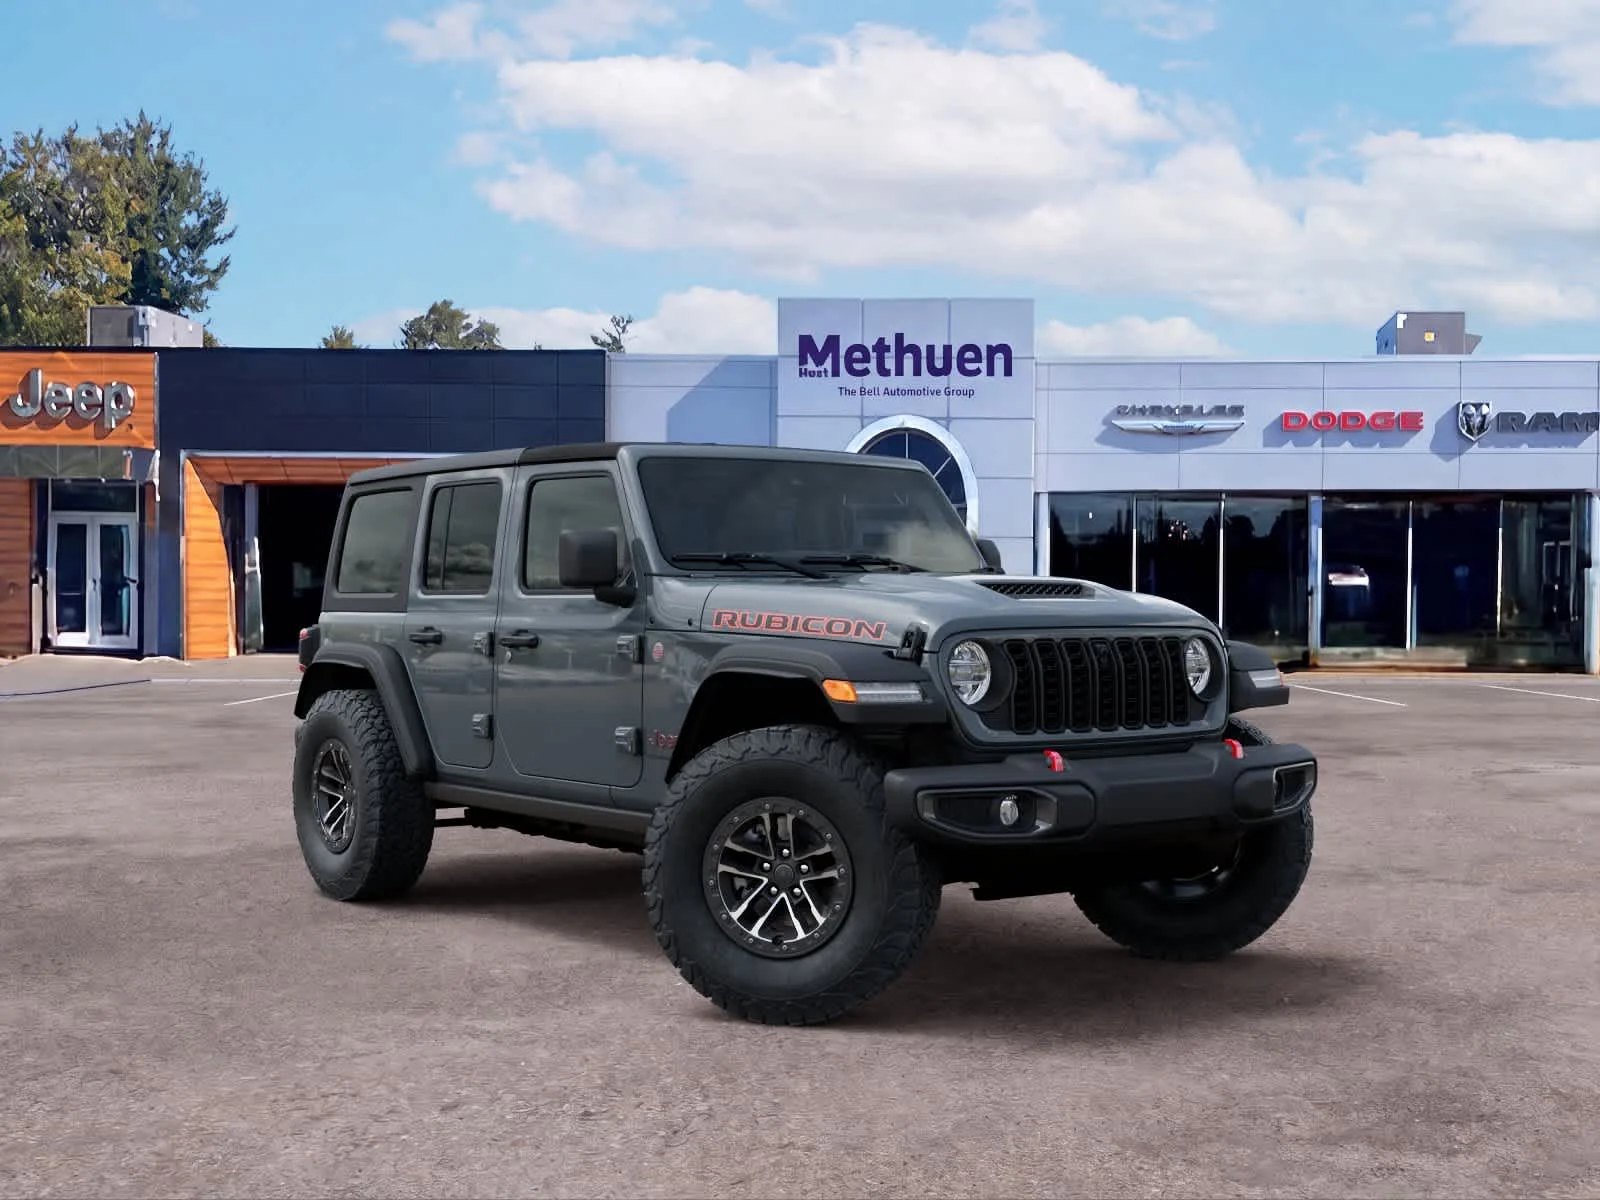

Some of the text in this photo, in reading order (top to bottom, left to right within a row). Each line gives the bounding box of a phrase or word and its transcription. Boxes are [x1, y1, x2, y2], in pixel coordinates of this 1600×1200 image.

[798, 332, 1013, 378] Methuen
[9, 368, 136, 429] Jeep
[837, 386, 976, 399] The Bell Automotive Group
[1281, 411, 1424, 432] DODGE
[1496, 411, 1600, 433] RAM
[712, 609, 887, 640] RUBICON
